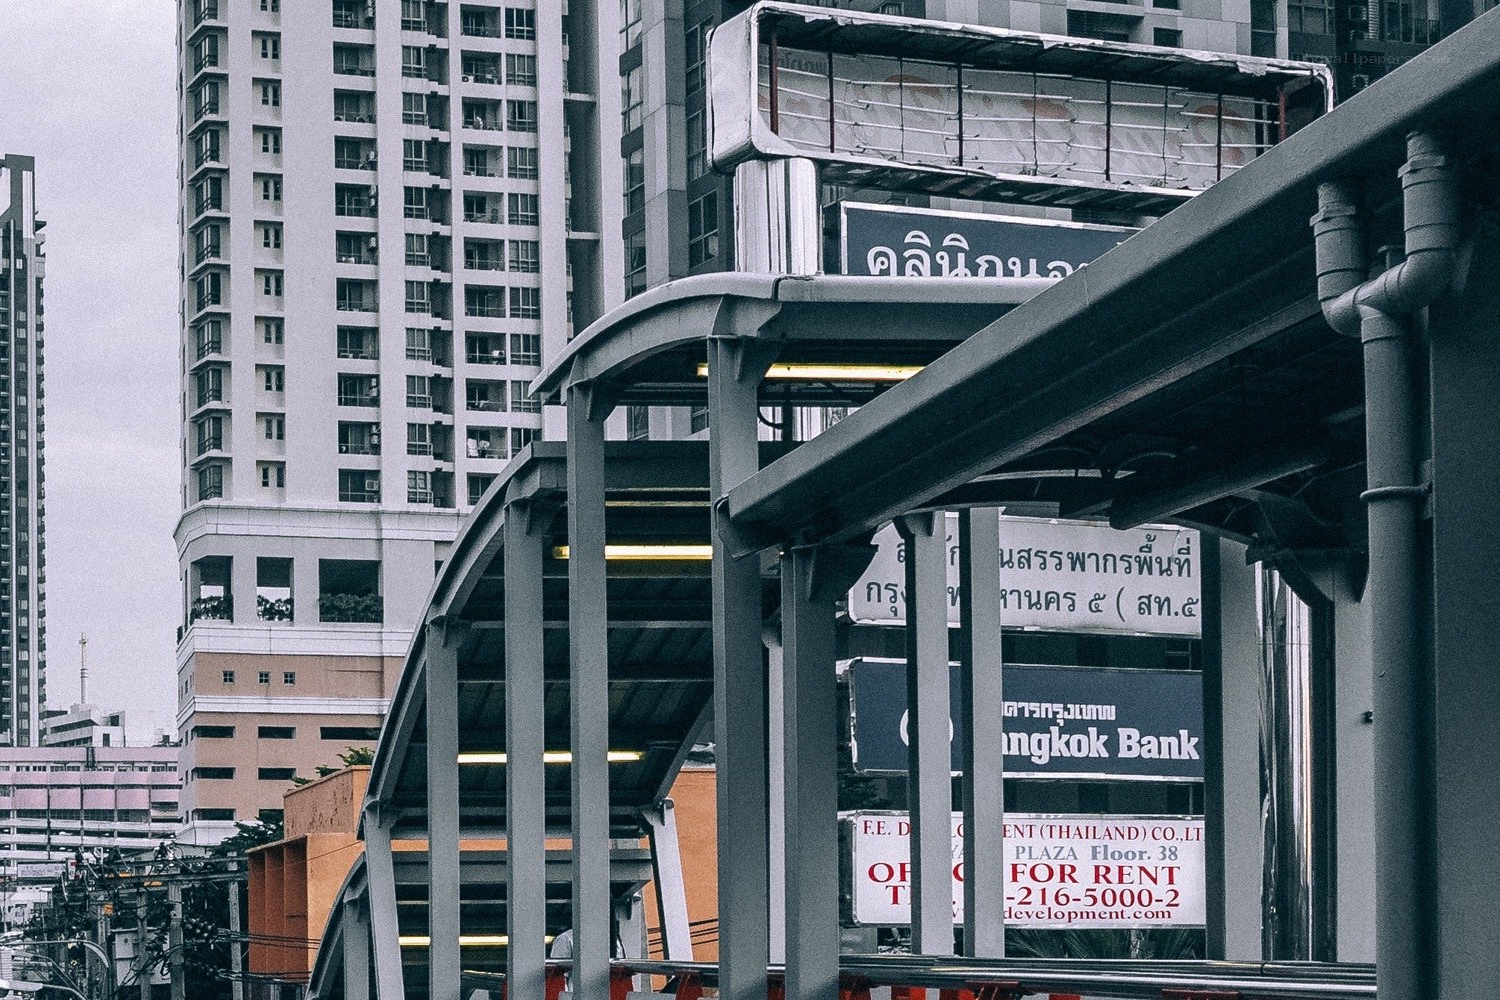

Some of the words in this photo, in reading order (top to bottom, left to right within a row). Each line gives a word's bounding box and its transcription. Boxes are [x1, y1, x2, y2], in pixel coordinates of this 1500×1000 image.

[1002, 701, 1116, 726] คารกรุงเทพ
[1002, 726, 1109, 765] ngkok
[1117, 728, 1201, 760] Bank
[863, 820, 891, 836] F.E.
[1039, 824, 1147, 842] (THAILAND)
[1151, 826, 1203, 843] CO.,LT
[1015, 845, 1078, 860] PLAZA
[1090, 844, 1151, 861] Floor.
[1157, 844, 1178, 861] 38
[1010, 863, 1078, 884] FOR
[1092, 865, 1181, 886] RENT
[1006, 886, 1181, 908] -216-5000-2
